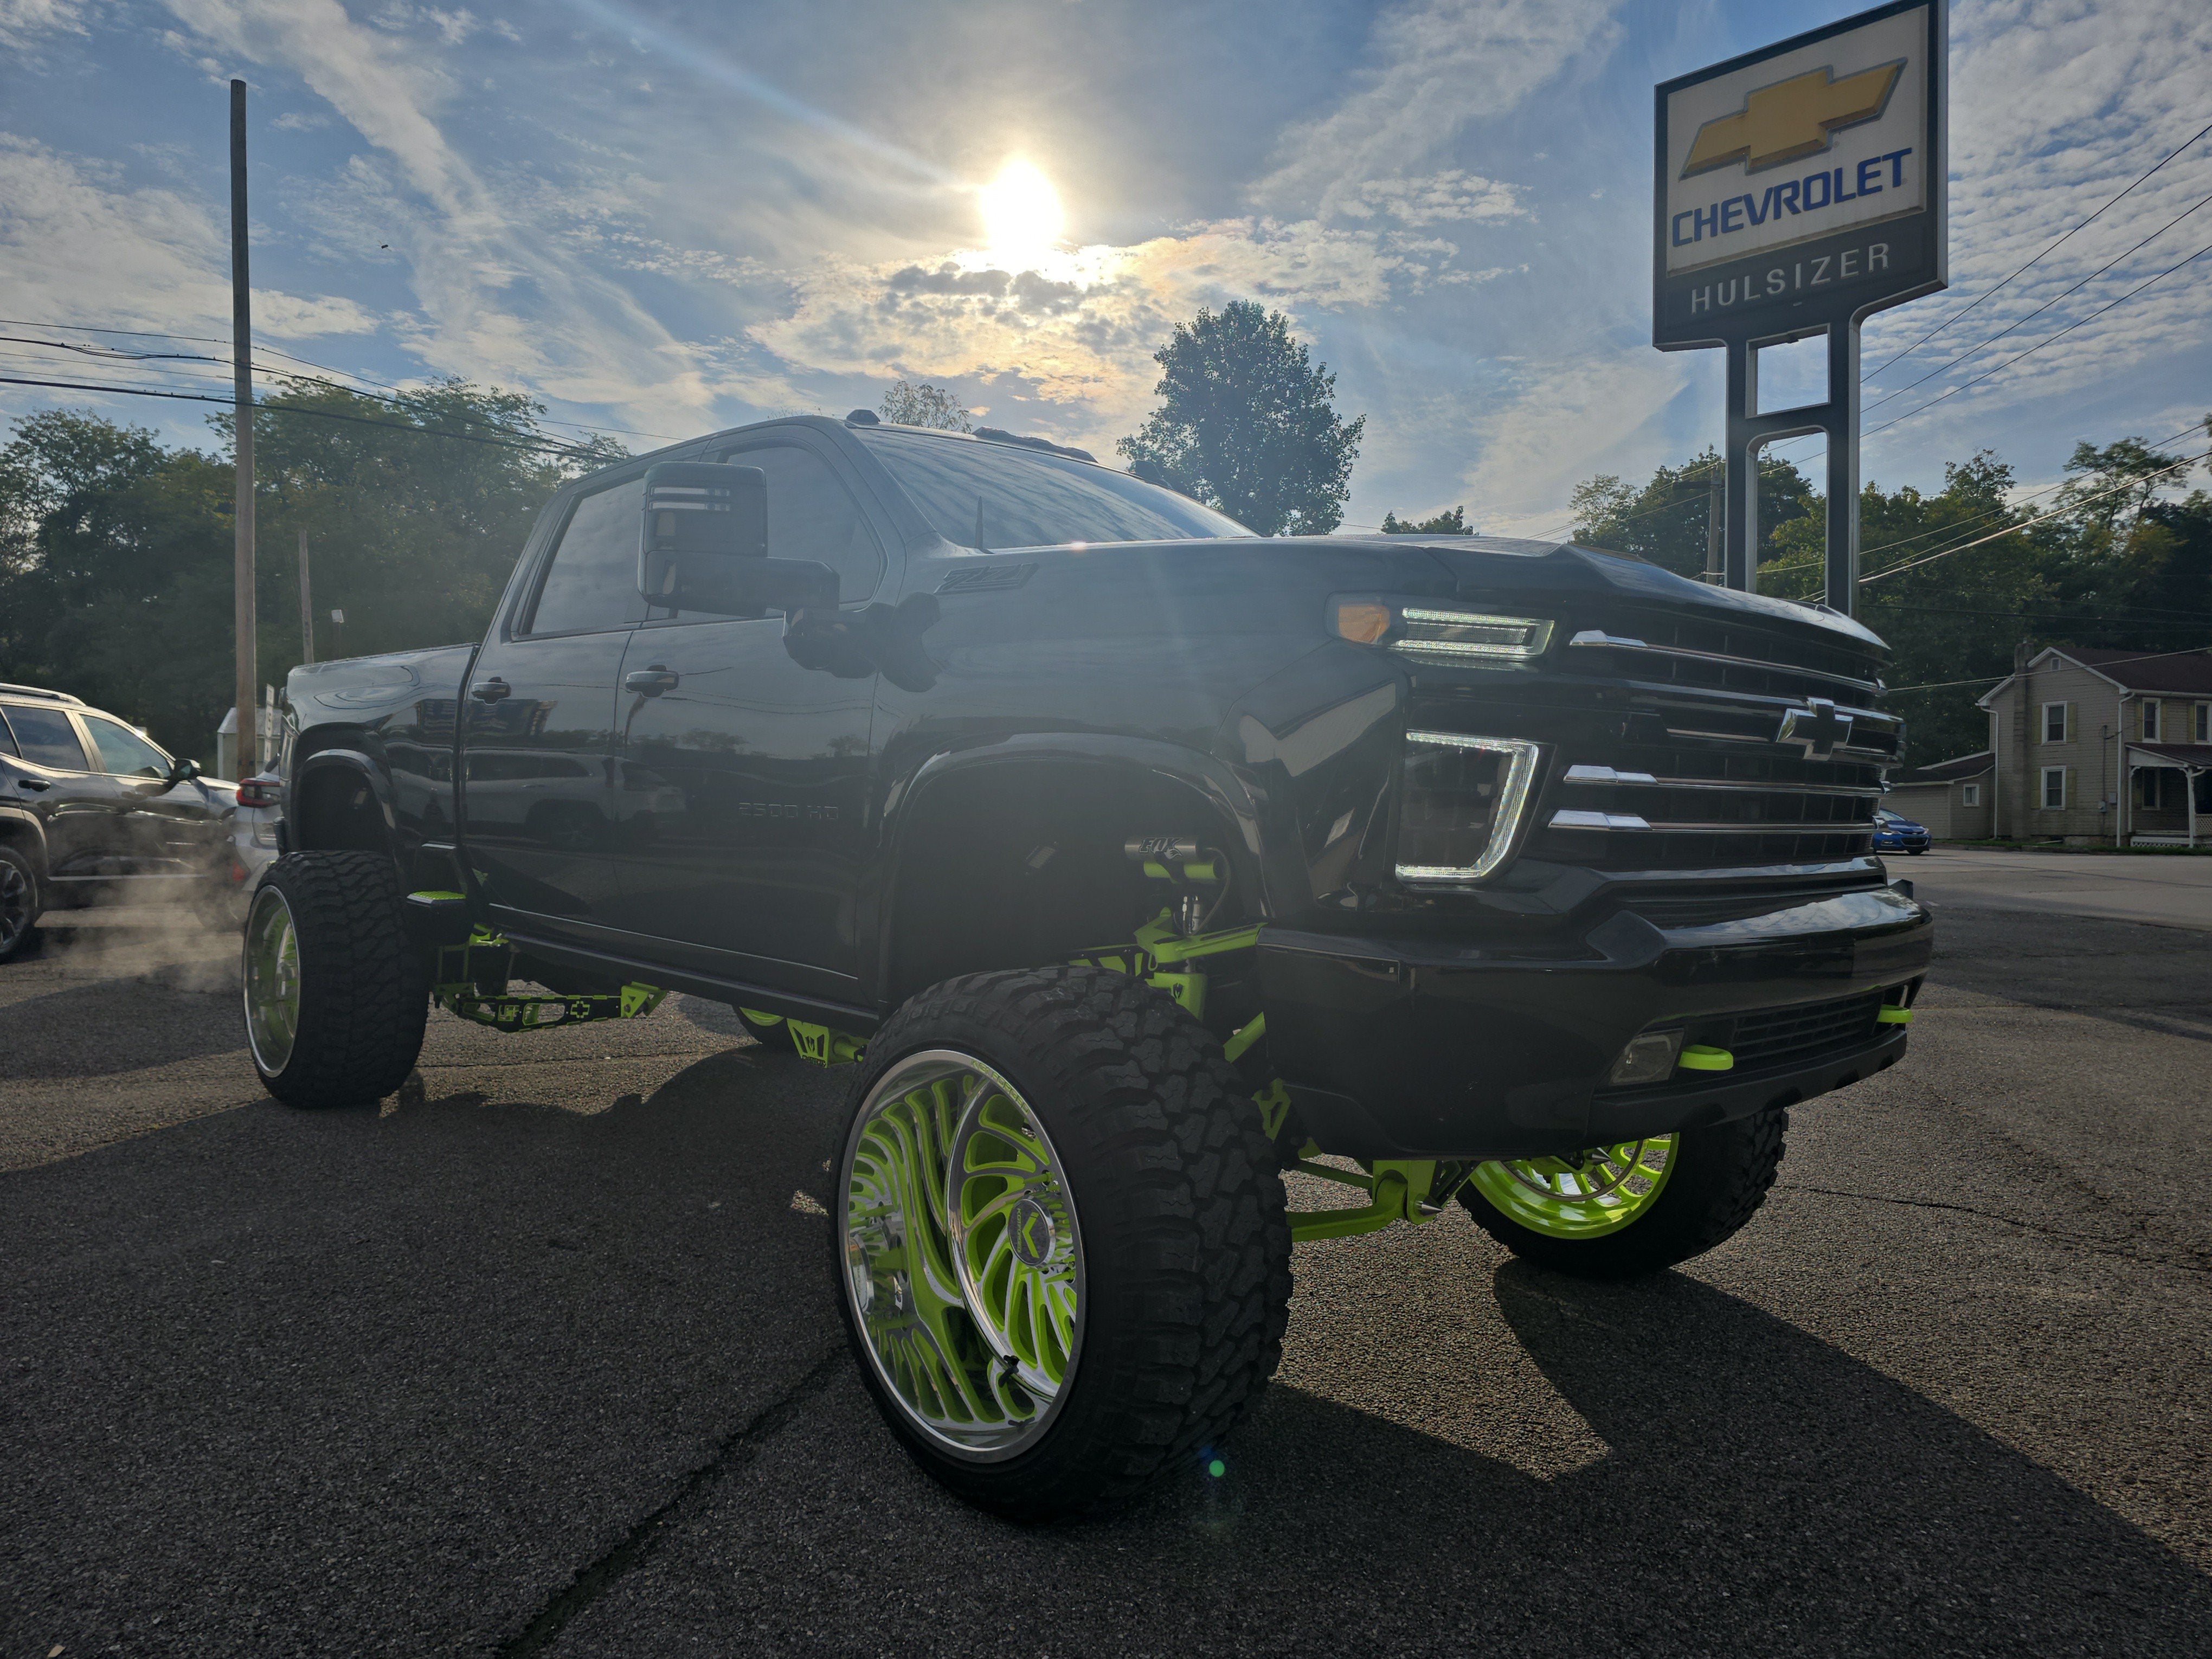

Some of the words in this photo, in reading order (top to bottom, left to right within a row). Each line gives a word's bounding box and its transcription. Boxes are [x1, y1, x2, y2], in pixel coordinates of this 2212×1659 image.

[1673, 147, 1912, 247] CHEVROLET
[1691, 243, 1889, 314] HULSIZER
[1139, 837, 1184, 859] FOX
[992, 1071, 1030, 1115] FORGED
